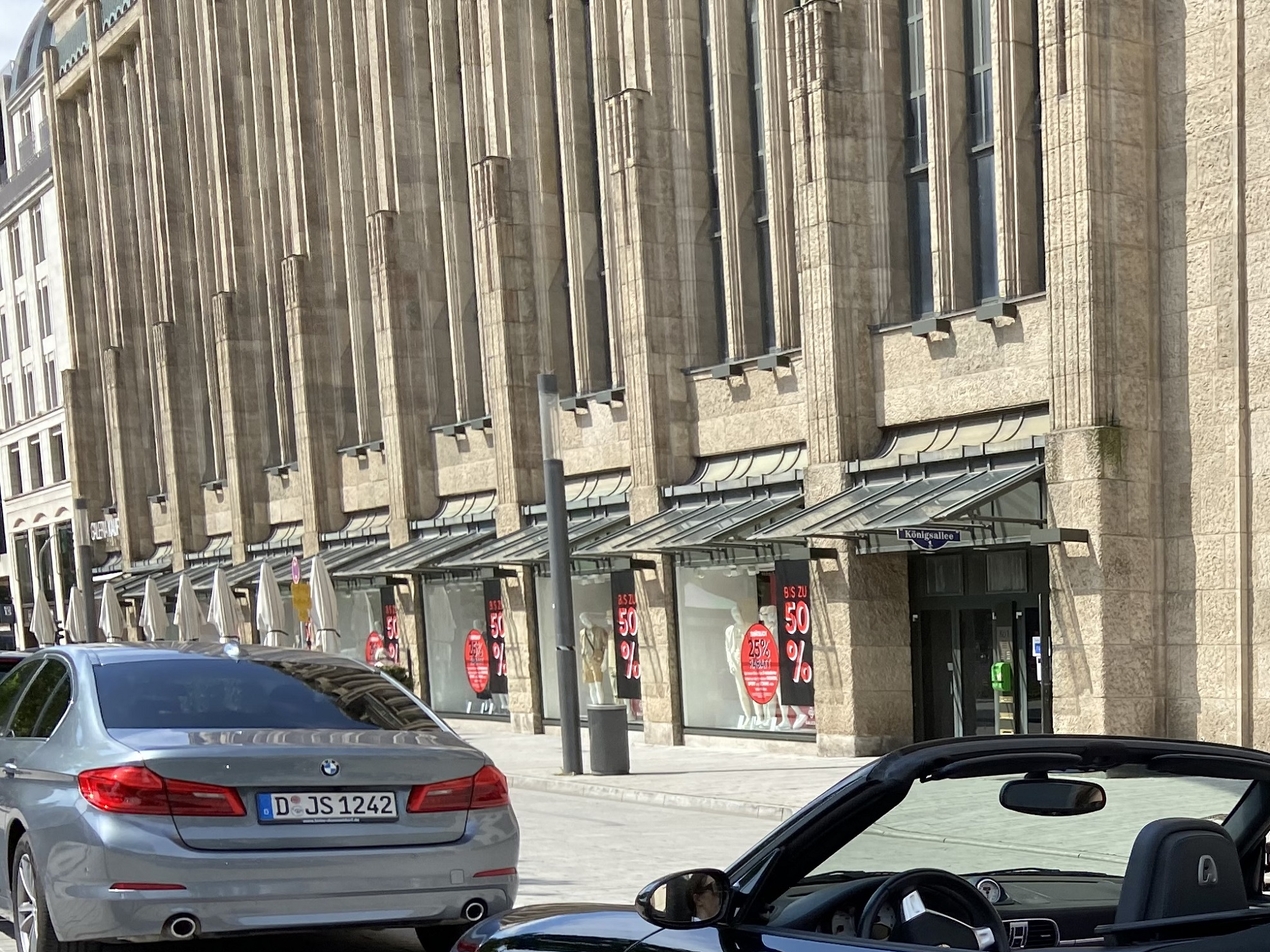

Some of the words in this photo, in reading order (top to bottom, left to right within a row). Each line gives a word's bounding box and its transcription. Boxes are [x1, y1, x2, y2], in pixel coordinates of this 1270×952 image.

[904, 530, 954, 541] Königsallee
[797, 586, 807, 598] ZU
[618, 607, 638, 636] 50
[784, 601, 810, 634] 50
[620, 641, 640, 679] %
[748, 639, 771, 658] 25%
[786, 639, 812, 683] %
[274, 797, 289, 815] D
[305, 796, 334, 815] JS
[339, 796, 393, 815] 1242
